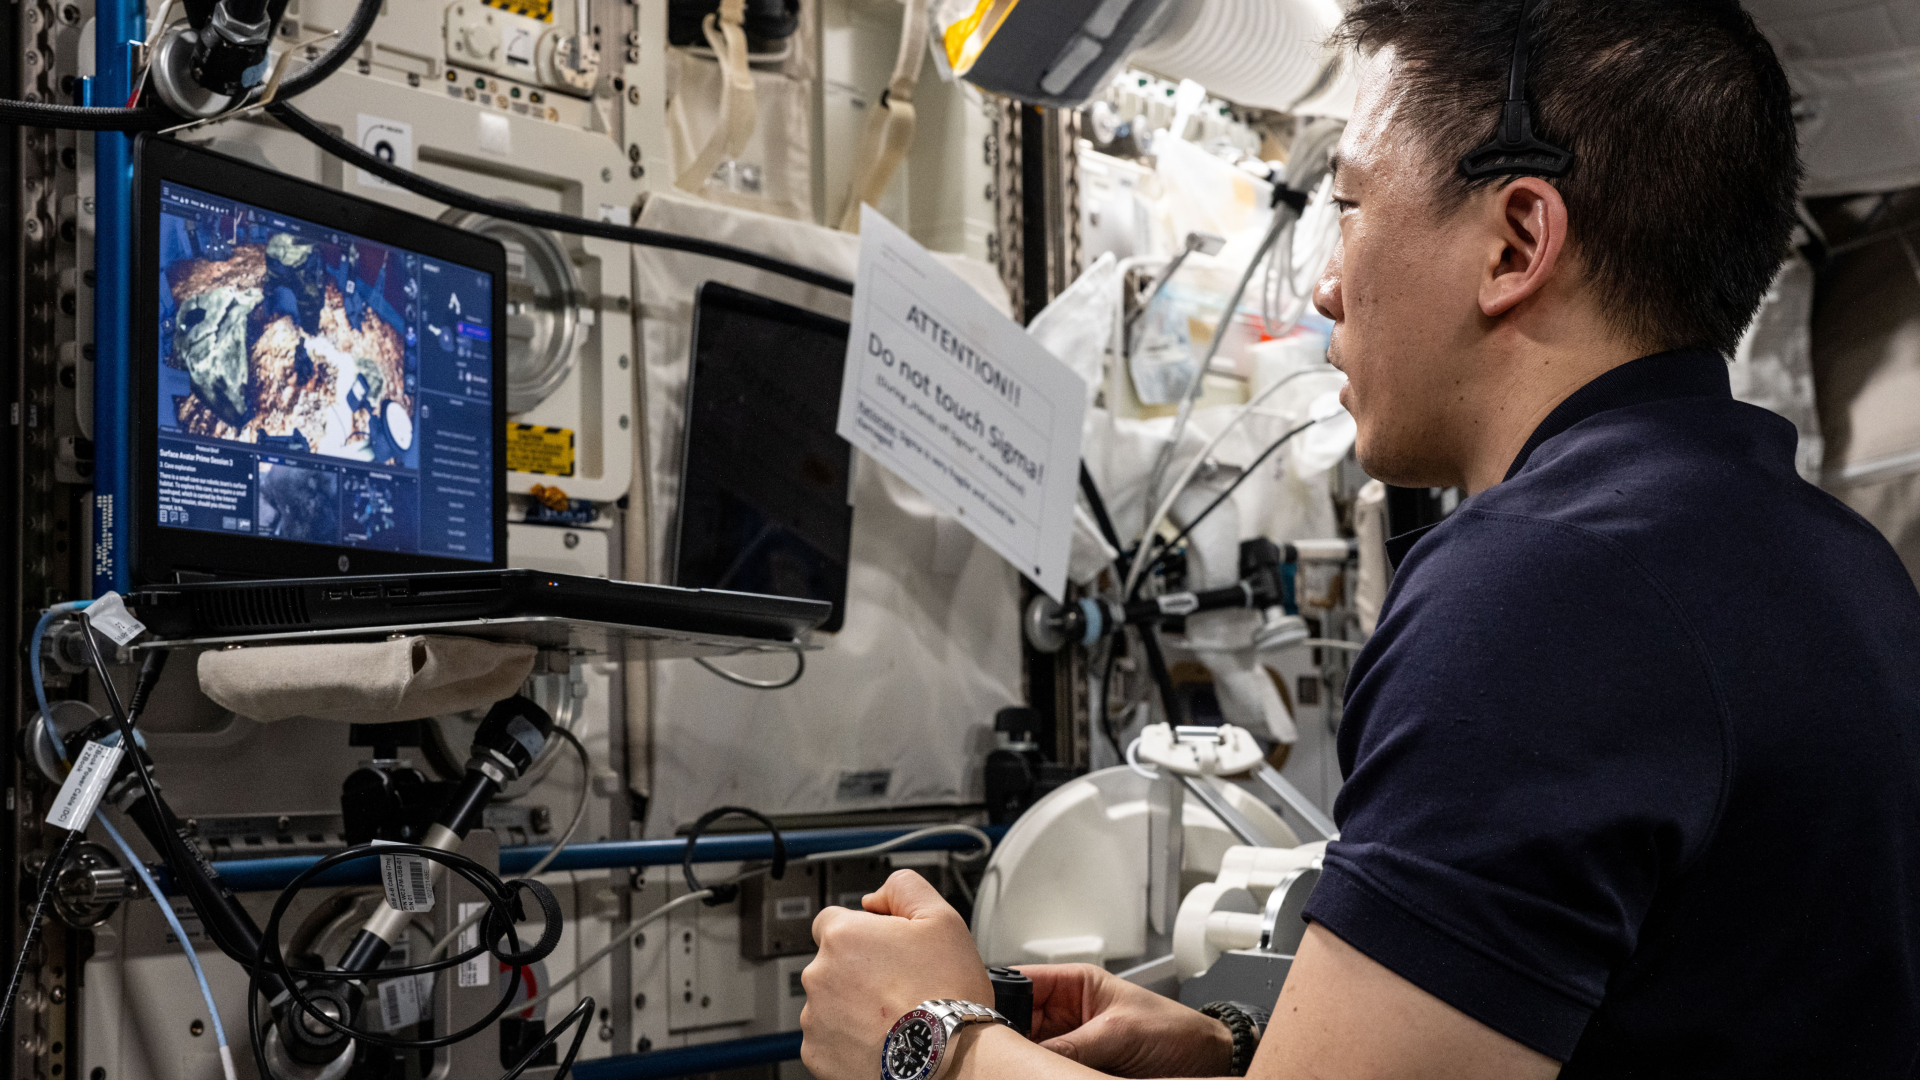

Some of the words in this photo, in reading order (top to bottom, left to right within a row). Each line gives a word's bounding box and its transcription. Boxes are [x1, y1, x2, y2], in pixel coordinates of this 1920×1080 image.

[906, 304, 1021, 407] ATTENTION!!
[868, 331, 895, 368] Do
[900, 361, 931, 397] not
[935, 384, 985, 438] touch
[989, 425, 1045, 486] Sigma!
[159, 449, 179, 459] Surface
[179, 451, 196, 461] Avatar
[195, 454, 210, 463] Prime
[210, 456, 229, 466] Session
[229, 459, 234, 467] 3
[87, 743, 96, 752] To
[77, 752, 91, 772] ZBook
[79, 767, 93, 787] Power
[67, 787, 81, 807] Cable
[58, 806, 70, 822] (DC)
[925, 1013, 933, 1021] 12
[933, 1024, 940, 1033] 14
[933, 1041, 940, 1051] 16
[926, 1059, 934, 1070] 18
